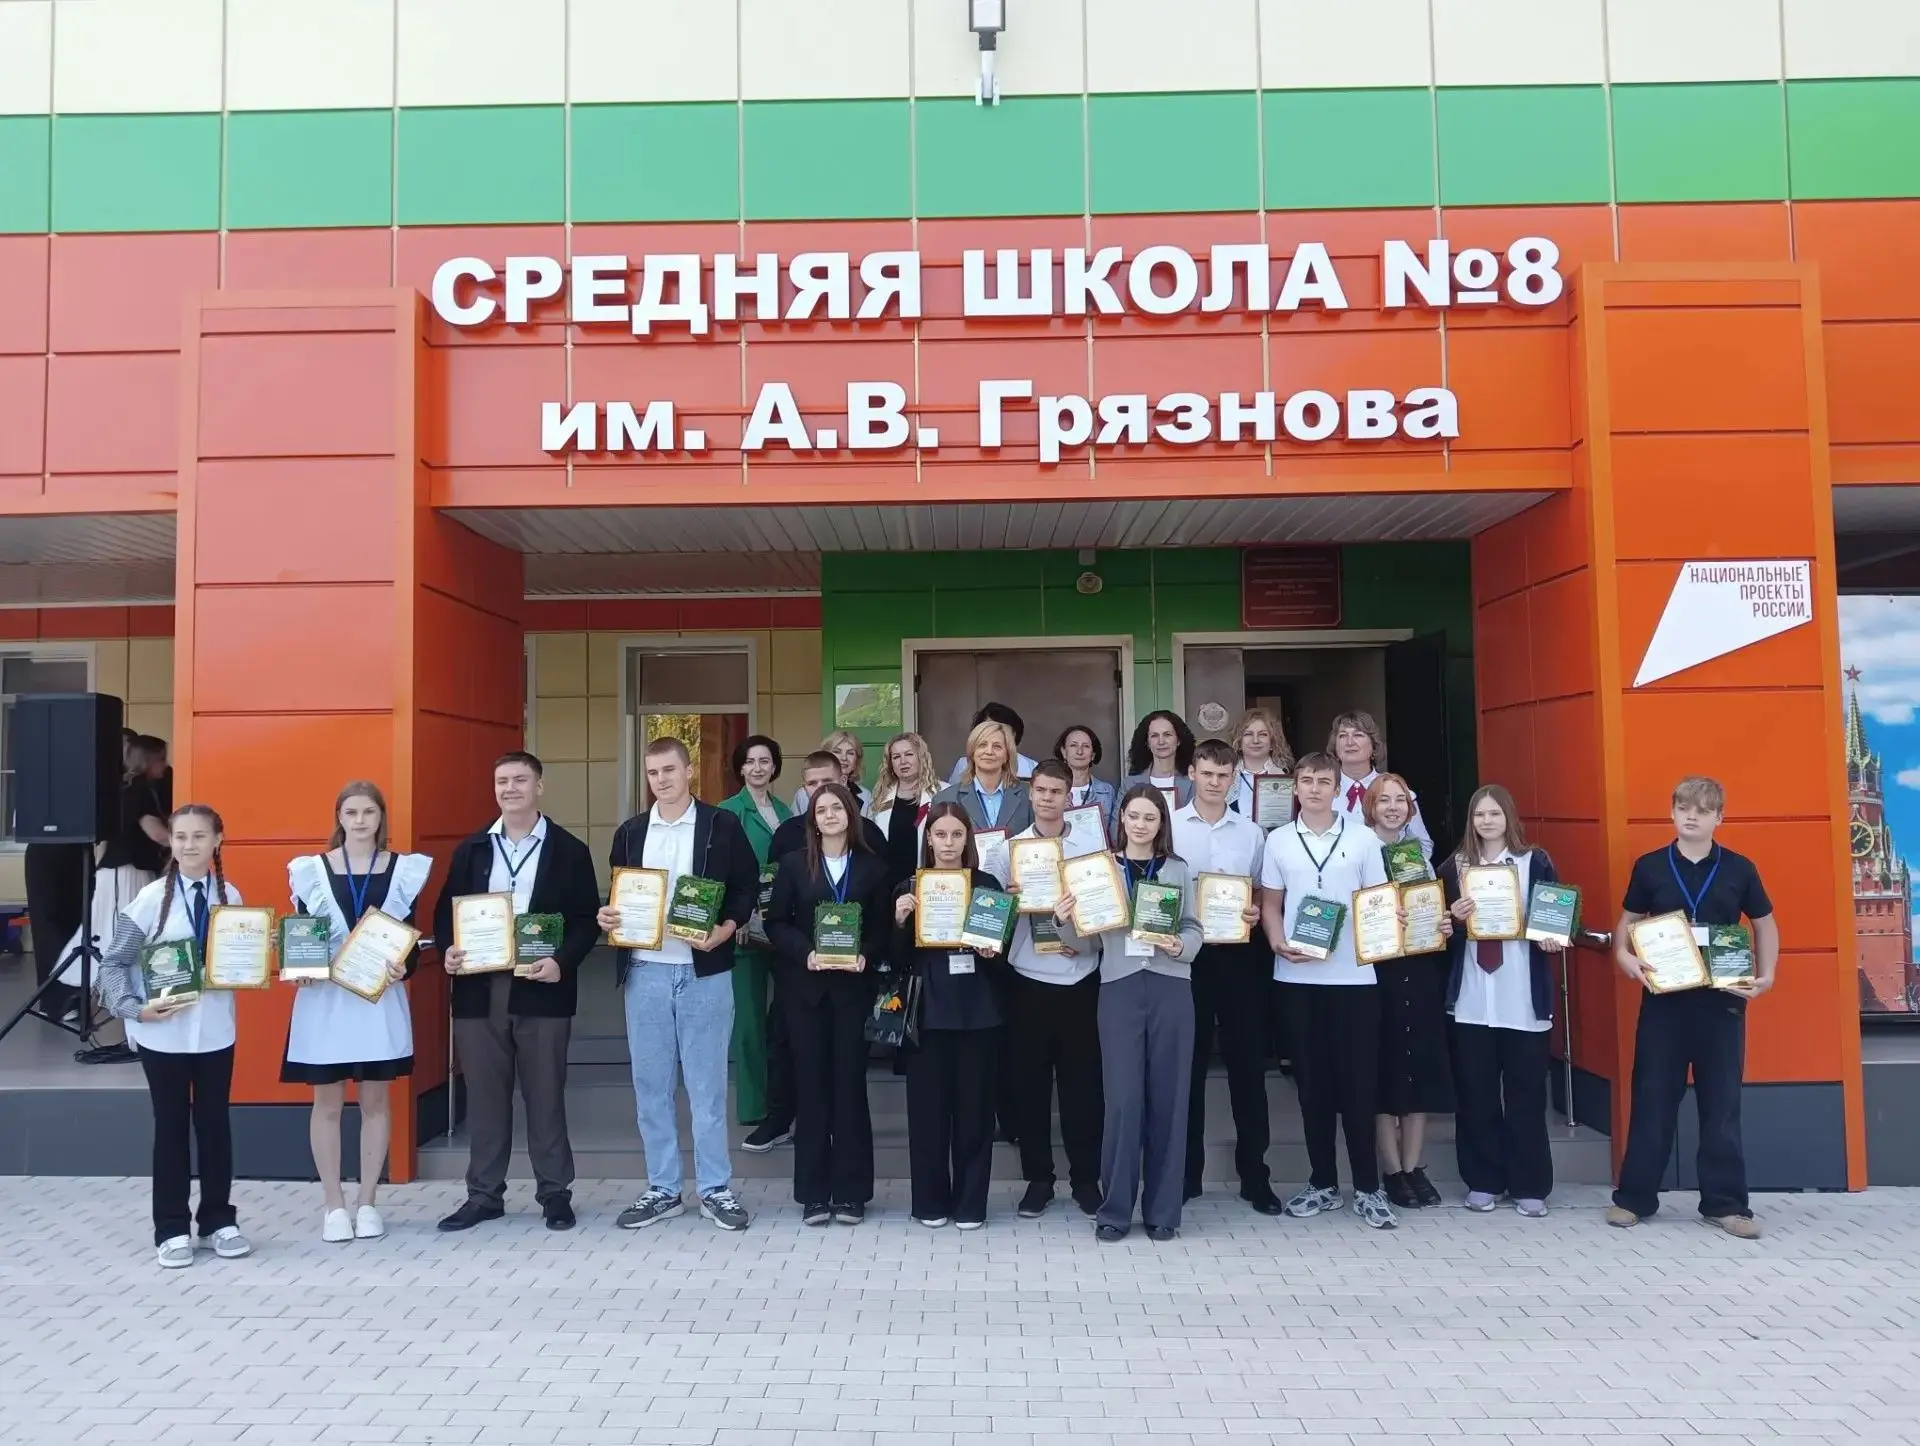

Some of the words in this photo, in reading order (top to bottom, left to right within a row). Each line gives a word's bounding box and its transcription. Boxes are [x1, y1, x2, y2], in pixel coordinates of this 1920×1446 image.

[431, 249, 921, 336] СРЕДНЯЯ
[963, 242, 1349, 316] ШКОЛА
[1382, 236, 1564, 308] №8
[541, 401, 706, 453] им.
[740, 381, 939, 451] А.В.
[979, 379, 1460, 464] Грязнова
[1690, 566, 1804, 584] НАЦИОНАЛЬНЫЕ
[1740, 583, 1804, 600] ПРОЕКТЫ
[1753, 601, 1805, 618] РОССИИ
